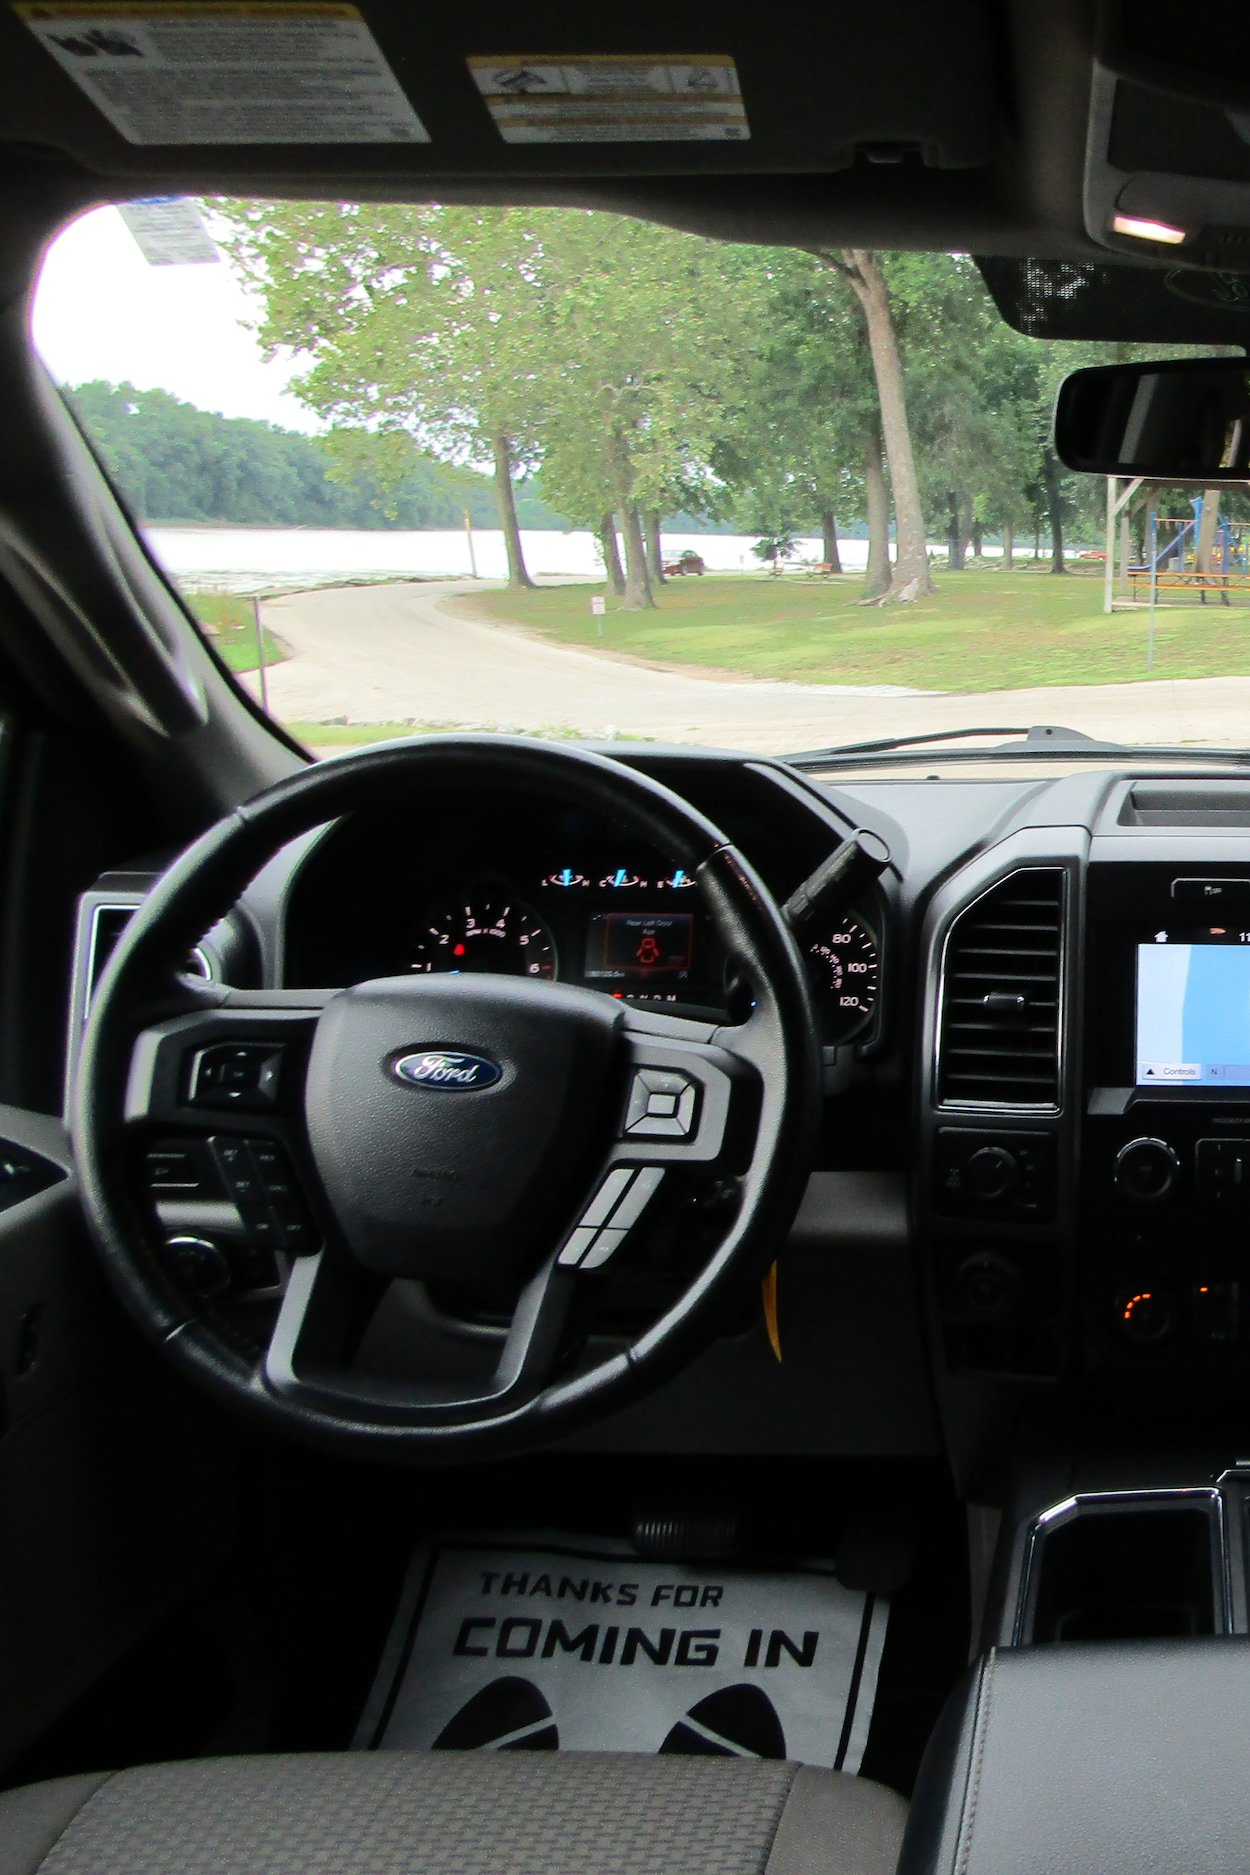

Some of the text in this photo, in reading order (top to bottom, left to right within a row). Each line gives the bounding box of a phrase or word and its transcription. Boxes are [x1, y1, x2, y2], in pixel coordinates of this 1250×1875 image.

[466, 918, 476, 929] 3
[496, 918, 506, 929] 4
[438, 934, 449, 945] 2
[519, 935, 530, 946] 5
[832, 933, 851, 944] 80
[426, 962, 432, 972] 1
[529, 963, 540, 974] 6
[847, 963, 867, 973] 100
[839, 996, 859, 1007] 120
[413, 1055, 480, 1083] Ford
[1163, 1067, 1196, 1076] Controls
[1211, 1068, 1217, 1076] N
[479, 1570, 724, 1607] THANKS FOR
[452, 1616, 820, 1667] COMING IN
